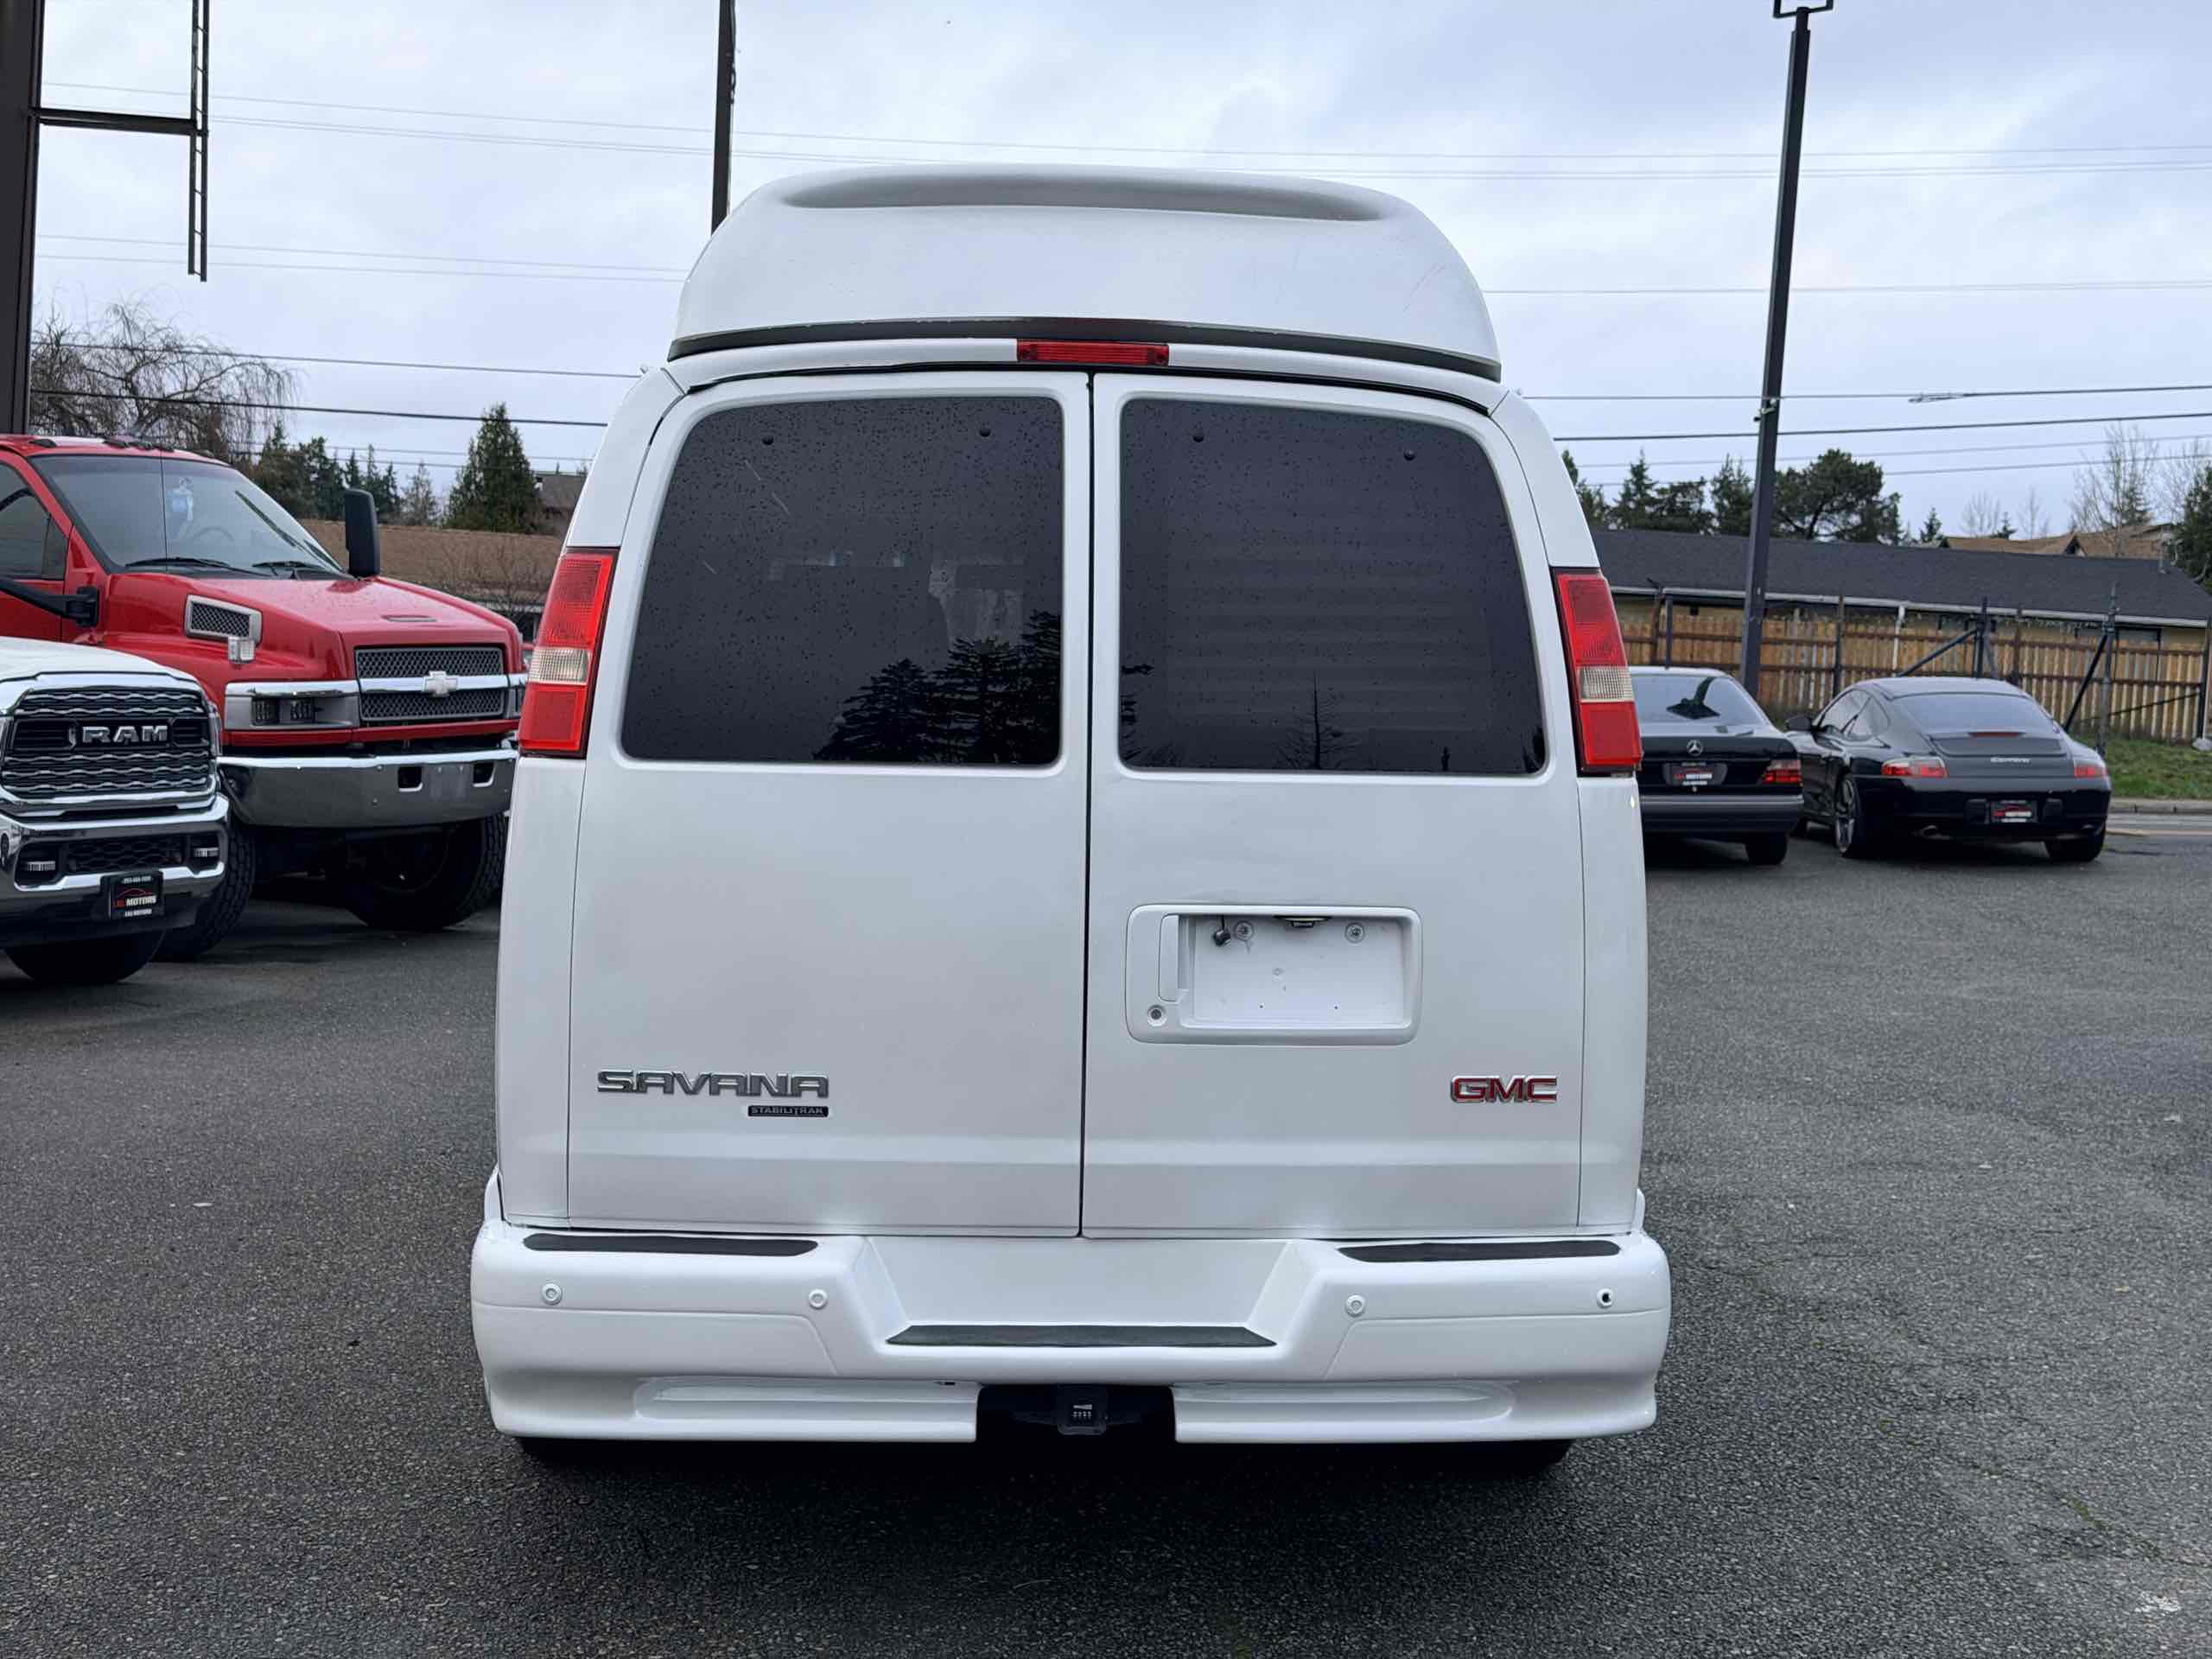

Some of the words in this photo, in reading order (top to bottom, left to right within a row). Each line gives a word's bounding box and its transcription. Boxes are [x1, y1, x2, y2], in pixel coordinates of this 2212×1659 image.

[82, 725, 168, 743] RAM
[126, 895, 156, 906] MOTORS
[597, 1070, 830, 1098] SAVANA
[1451, 1075, 1558, 1103] GMC
